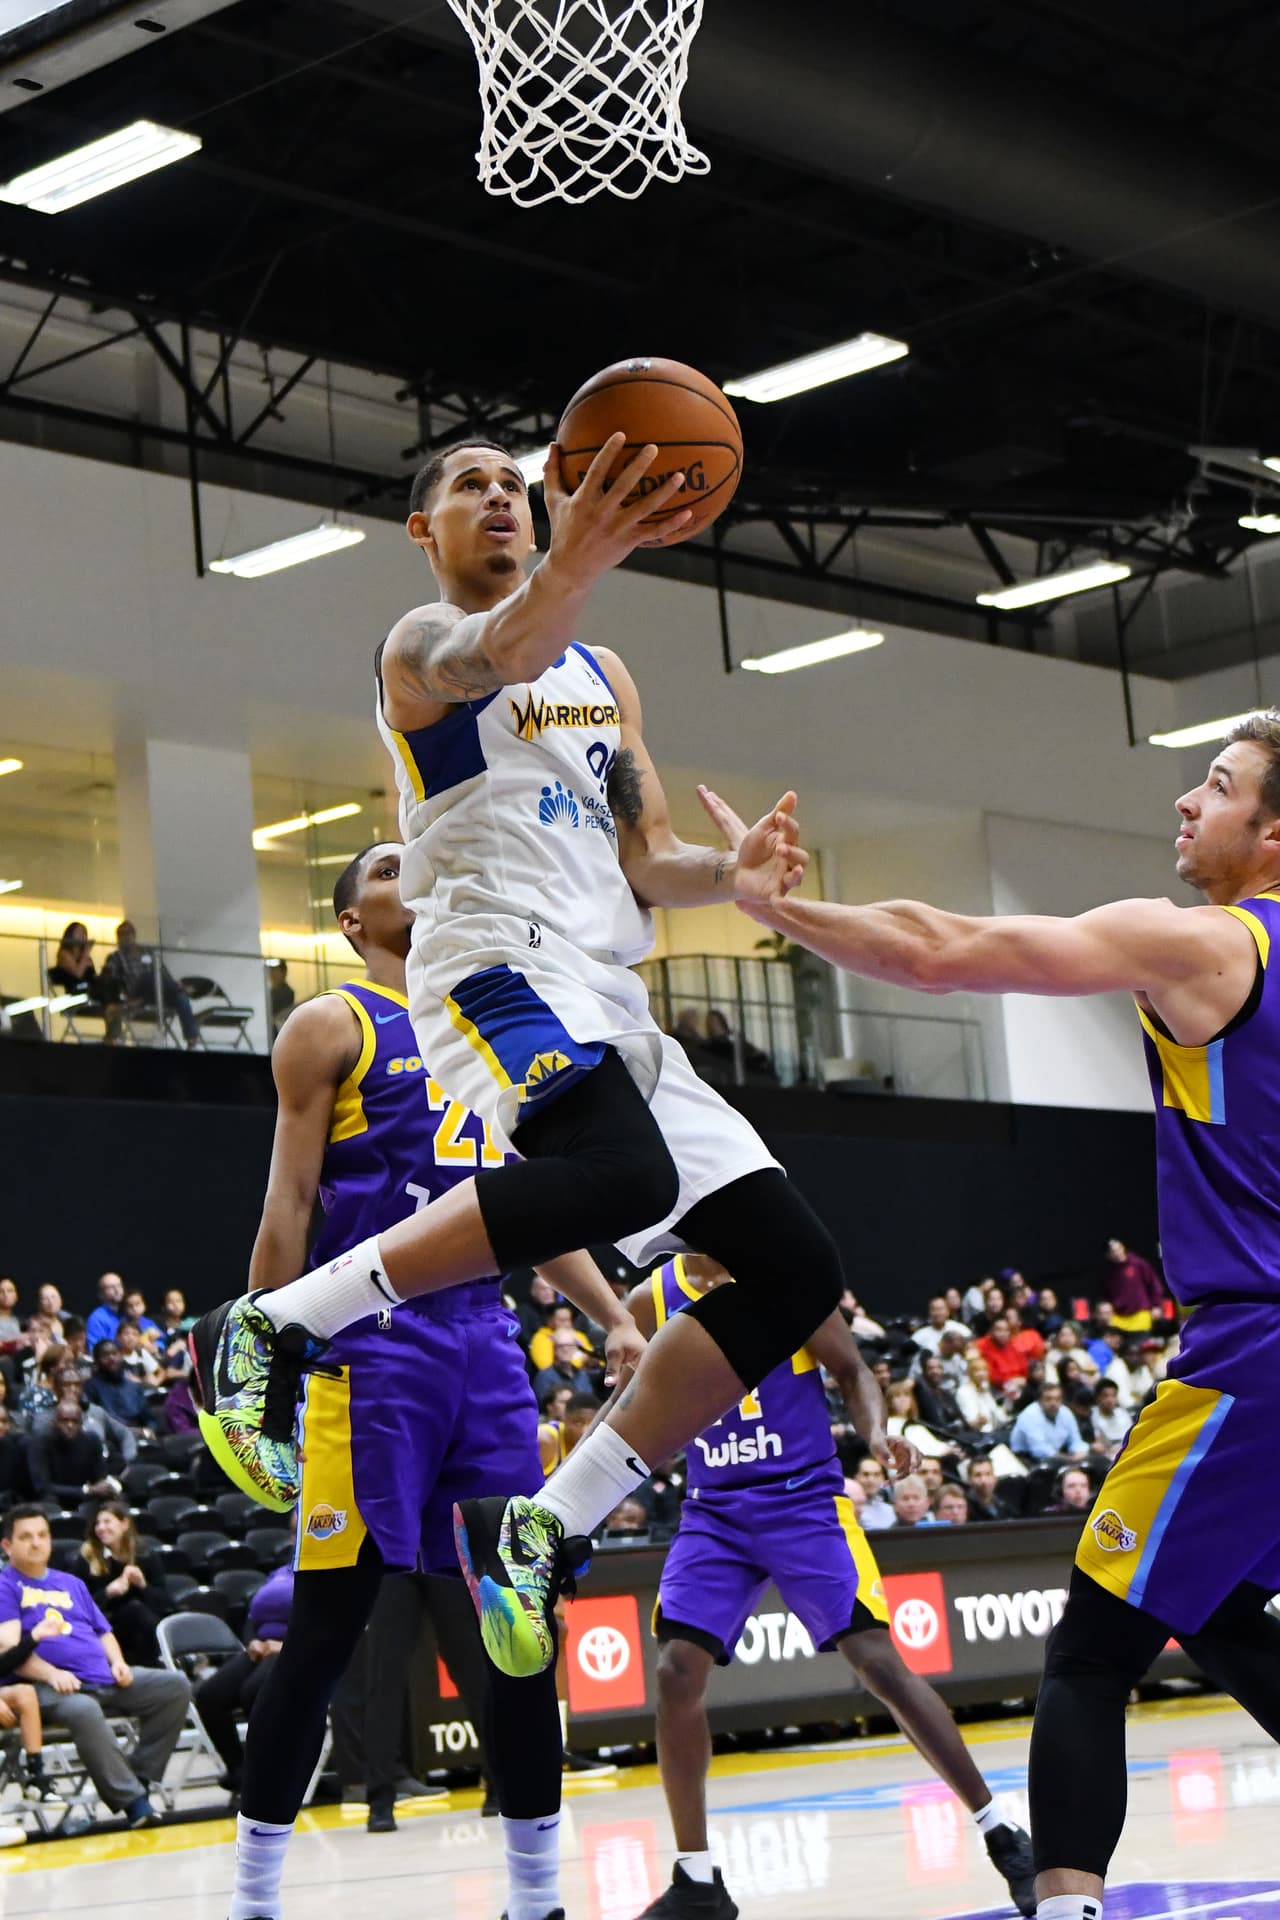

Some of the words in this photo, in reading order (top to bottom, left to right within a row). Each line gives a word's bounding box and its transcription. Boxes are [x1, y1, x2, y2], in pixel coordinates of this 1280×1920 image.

[386, 1056, 423, 1075] SO
[694, 1425, 782, 1467] wish
[734, 1611, 816, 1664] OTA
[954, 1588, 1070, 1642] TOYOT
